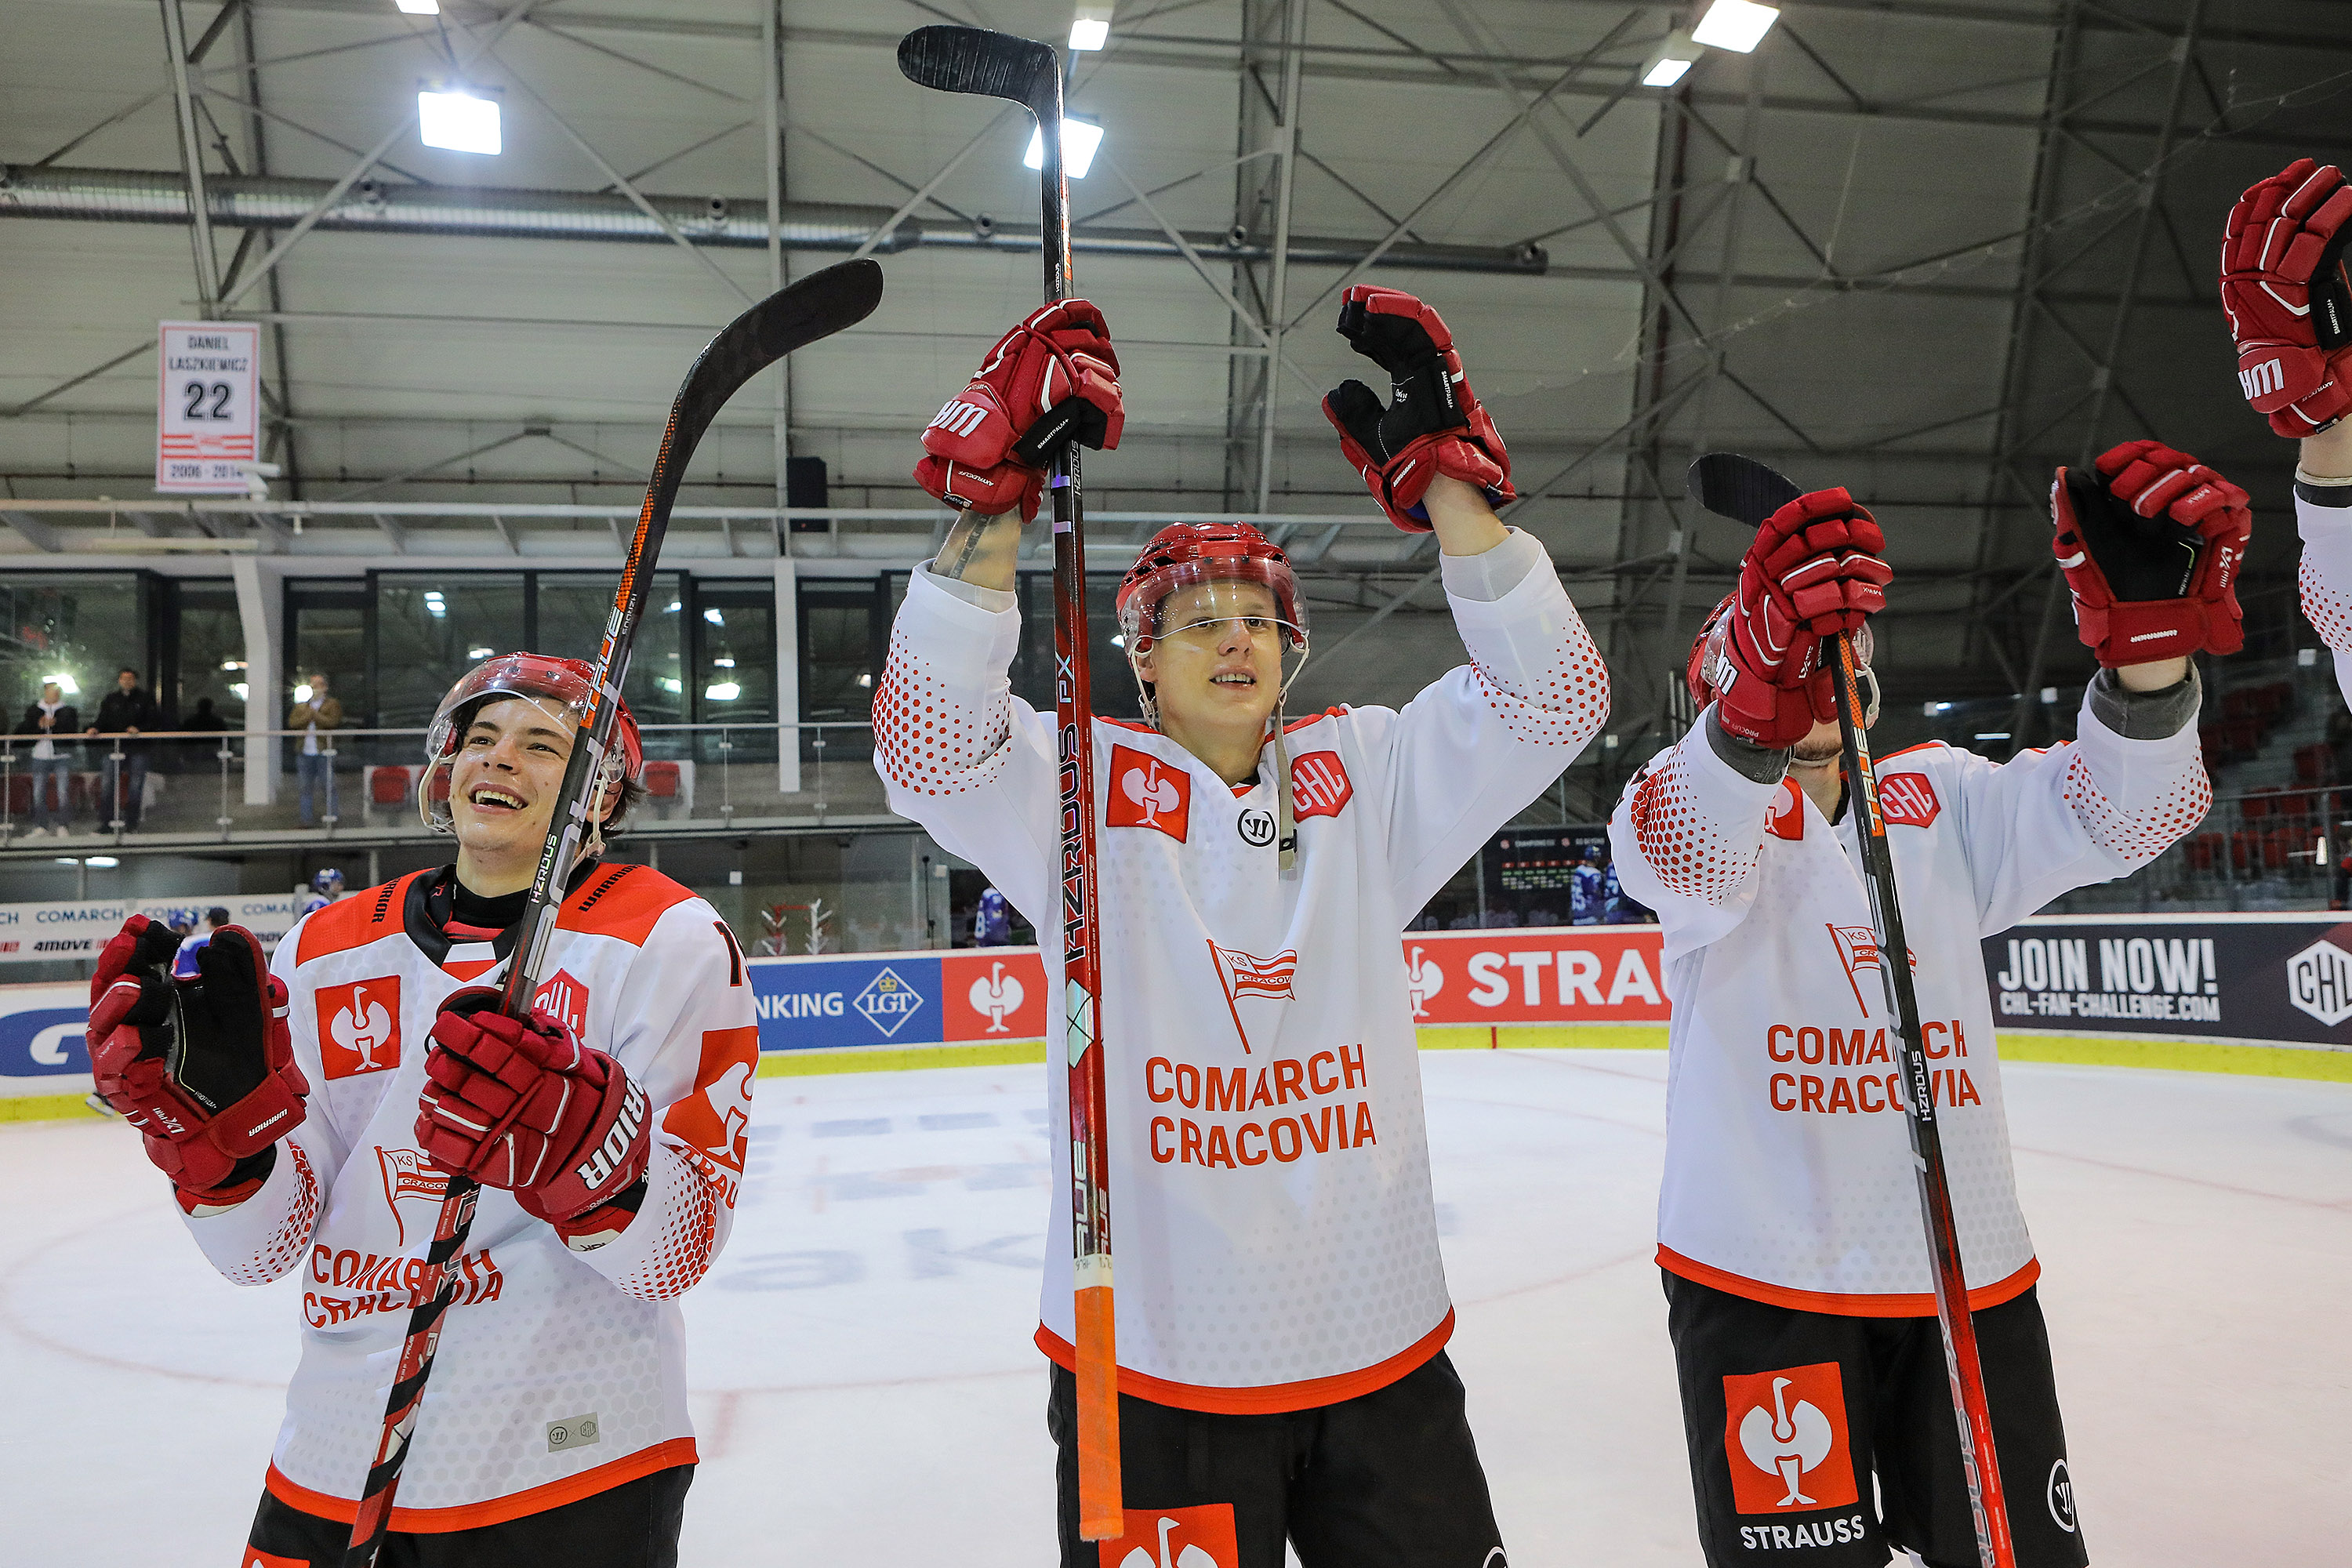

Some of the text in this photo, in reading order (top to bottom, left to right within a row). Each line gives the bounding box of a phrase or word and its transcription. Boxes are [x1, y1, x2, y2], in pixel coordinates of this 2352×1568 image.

[183, 380, 233, 422] 22
[1292, 757, 1346, 813] CHL
[1853, 726, 1882, 831] TRUE
[1879, 777, 1934, 819] CHL
[1058, 722, 1087, 964] HZRDUS
[531, 833, 558, 904] HZRDUS
[36, 907, 124, 924] COMARCH
[372, 877, 402, 924] RRIOR
[1848, 931, 1868, 941] KS
[1227, 954, 1247, 967] KS
[1242, 975, 1291, 985] CRACOV
[1466, 948, 1670, 1008] STRA
[1998, 937, 2219, 996] JOIN NOW!
[2297, 953, 2352, 1013] CHL
[755, 991, 844, 1020] NKING
[866, 992, 913, 1014] LGT
[1999, 990, 2222, 1022] CHL-FAN-CHALLENGE.COM
[1767, 1019, 1969, 1066] COMACH
[1145, 1044, 1367, 1112] COMARCH
[1911, 1050, 1932, 1122] HZRDUS
[248, 1108, 289, 1138] WARRIOR
[576, 1077, 646, 1190] RIOR
[1149, 1101, 1377, 1170] CRACOVIA
[397, 1155, 414, 1167] KS
[1073, 1140, 1089, 1258] RUE
[1099, 1187, 1110, 1254] RUE
[312, 1243, 499, 1292] COMARH
[1742, 1515, 1866, 1551] STRAUSS
